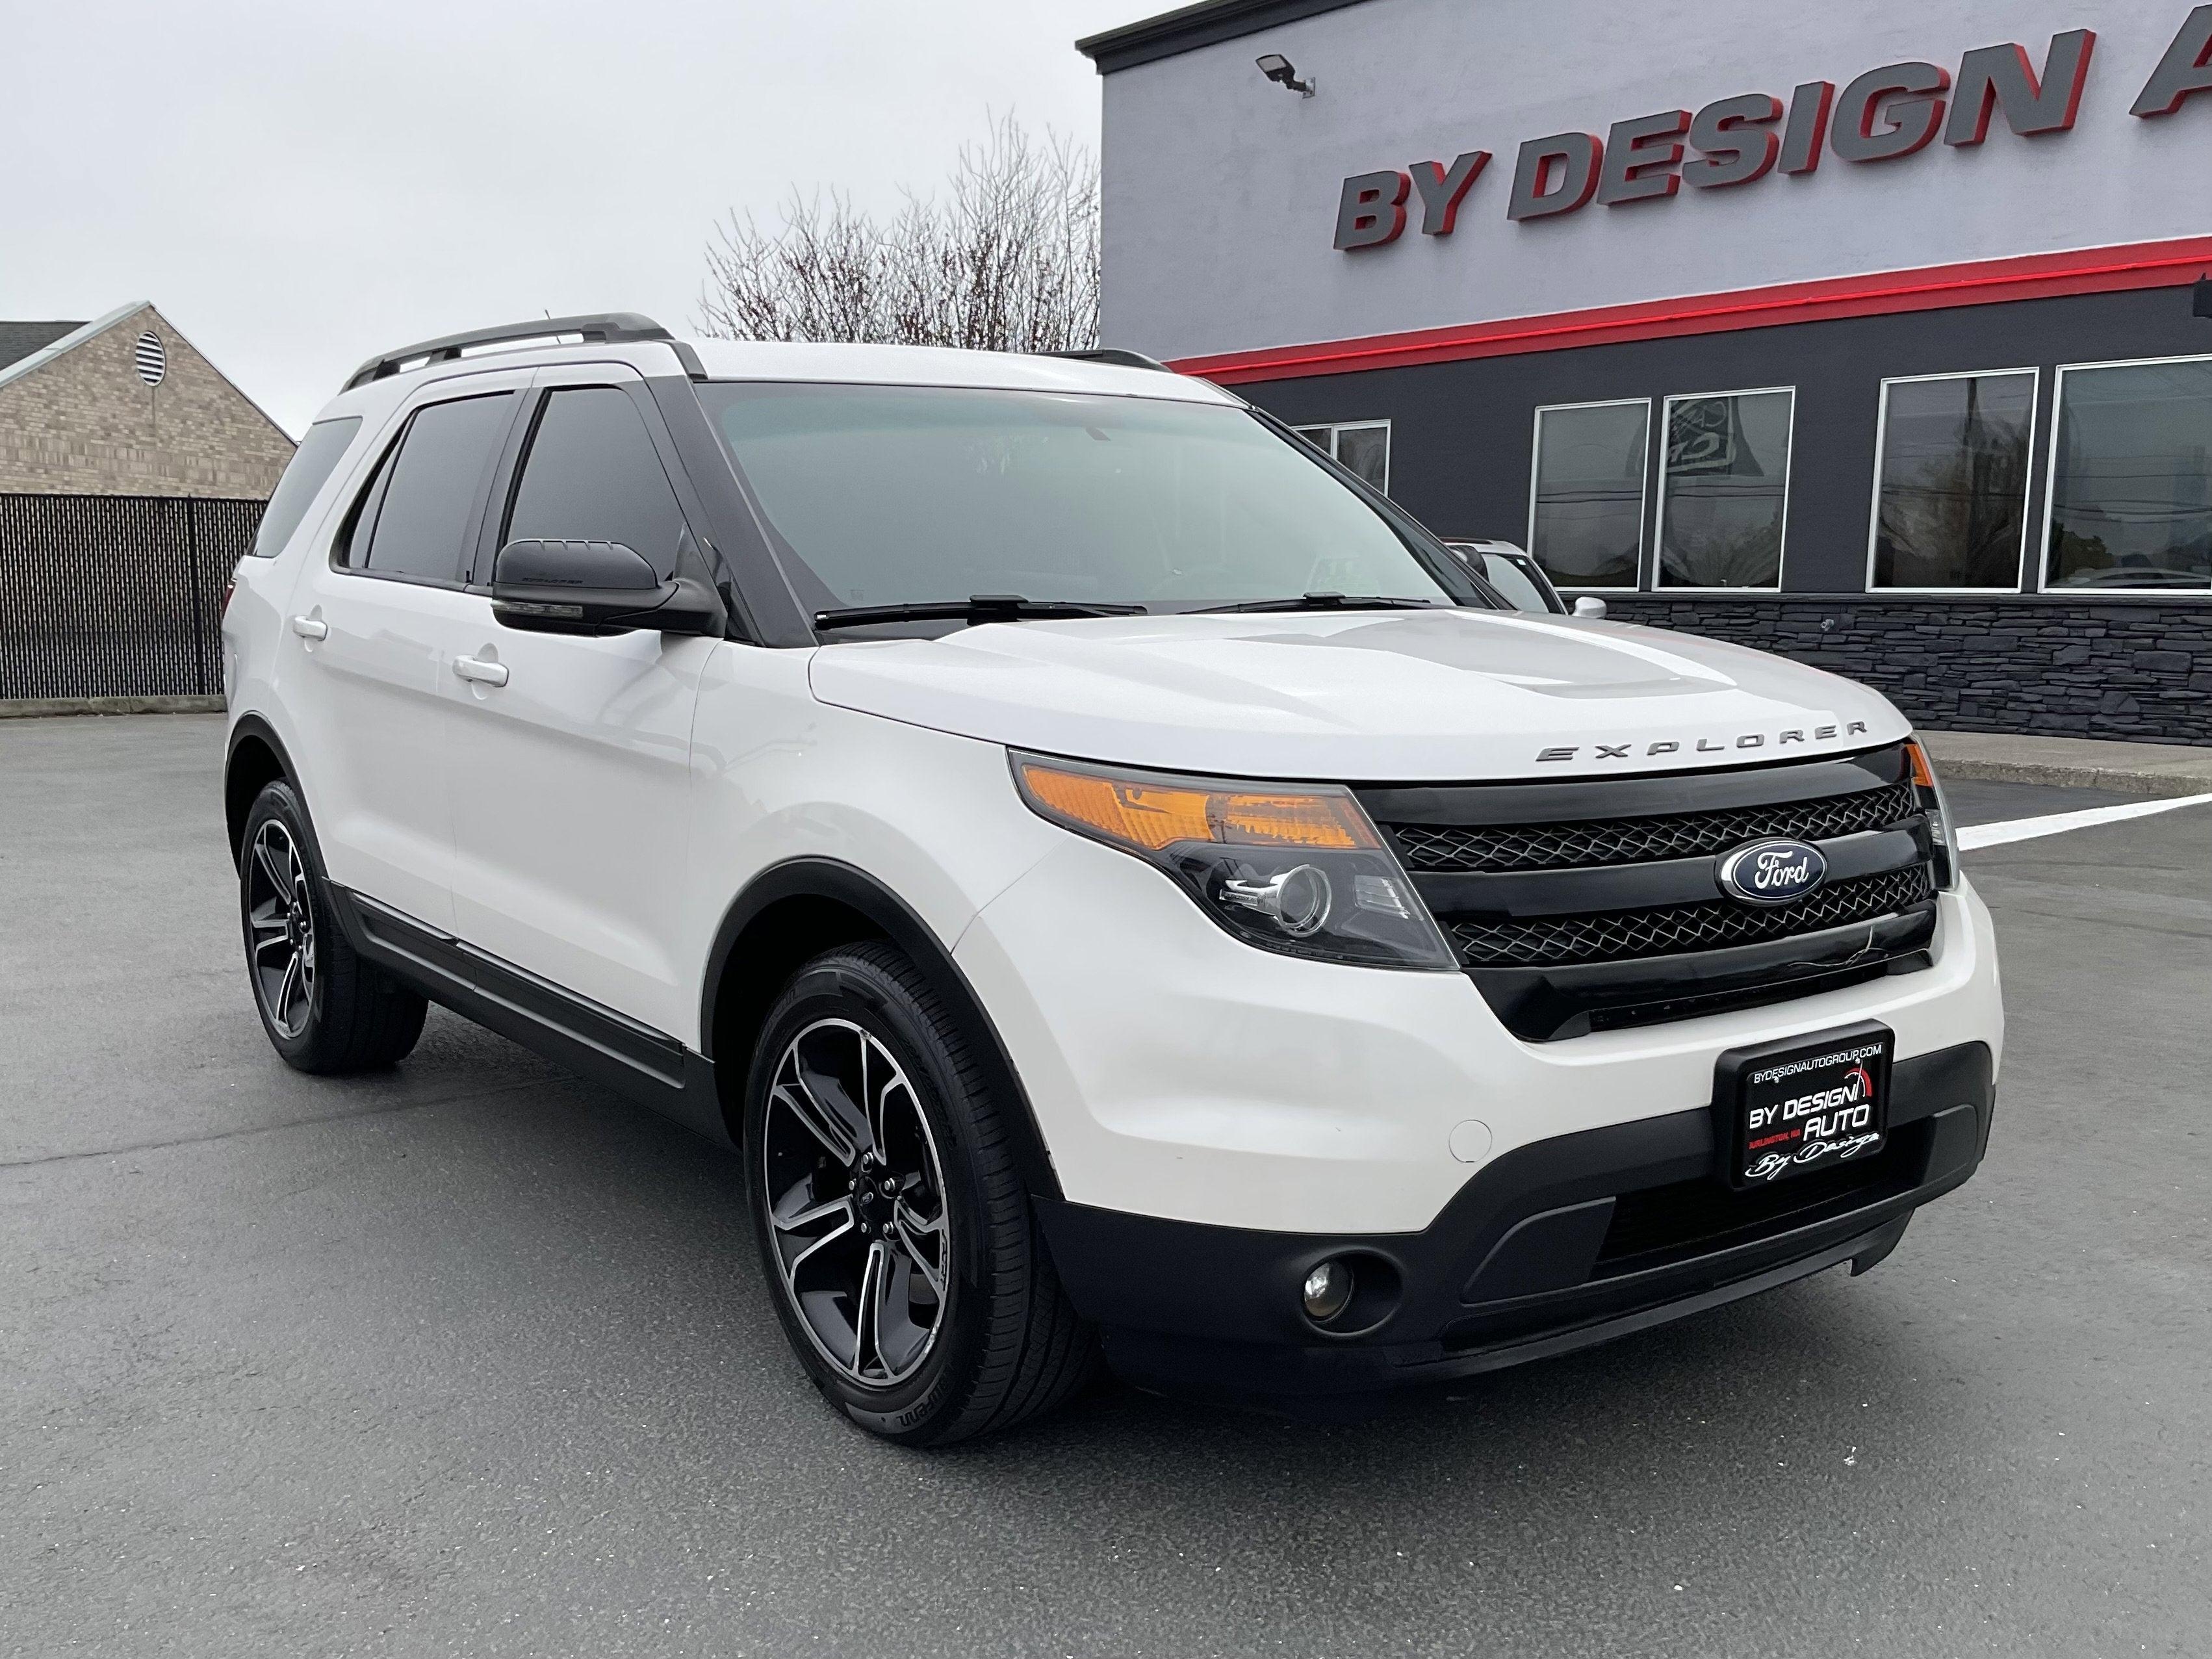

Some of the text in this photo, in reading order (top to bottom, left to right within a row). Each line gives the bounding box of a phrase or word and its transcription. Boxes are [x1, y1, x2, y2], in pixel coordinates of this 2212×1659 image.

[1333, 149, 1492, 251] BY
[1506, 28, 2096, 222] DESIGN
[1535, 721, 1867, 761] EXPLORER
[1754, 851, 1809, 889] Ford
[1754, 1044, 1882, 1084] BYDESIGNAUTOGROUP.COM
[1749, 1083, 1857, 1129] BY DESIGN
[1803, 1103, 1870, 1141] AUTO
[1745, 1132, 1880, 1181] By Design
